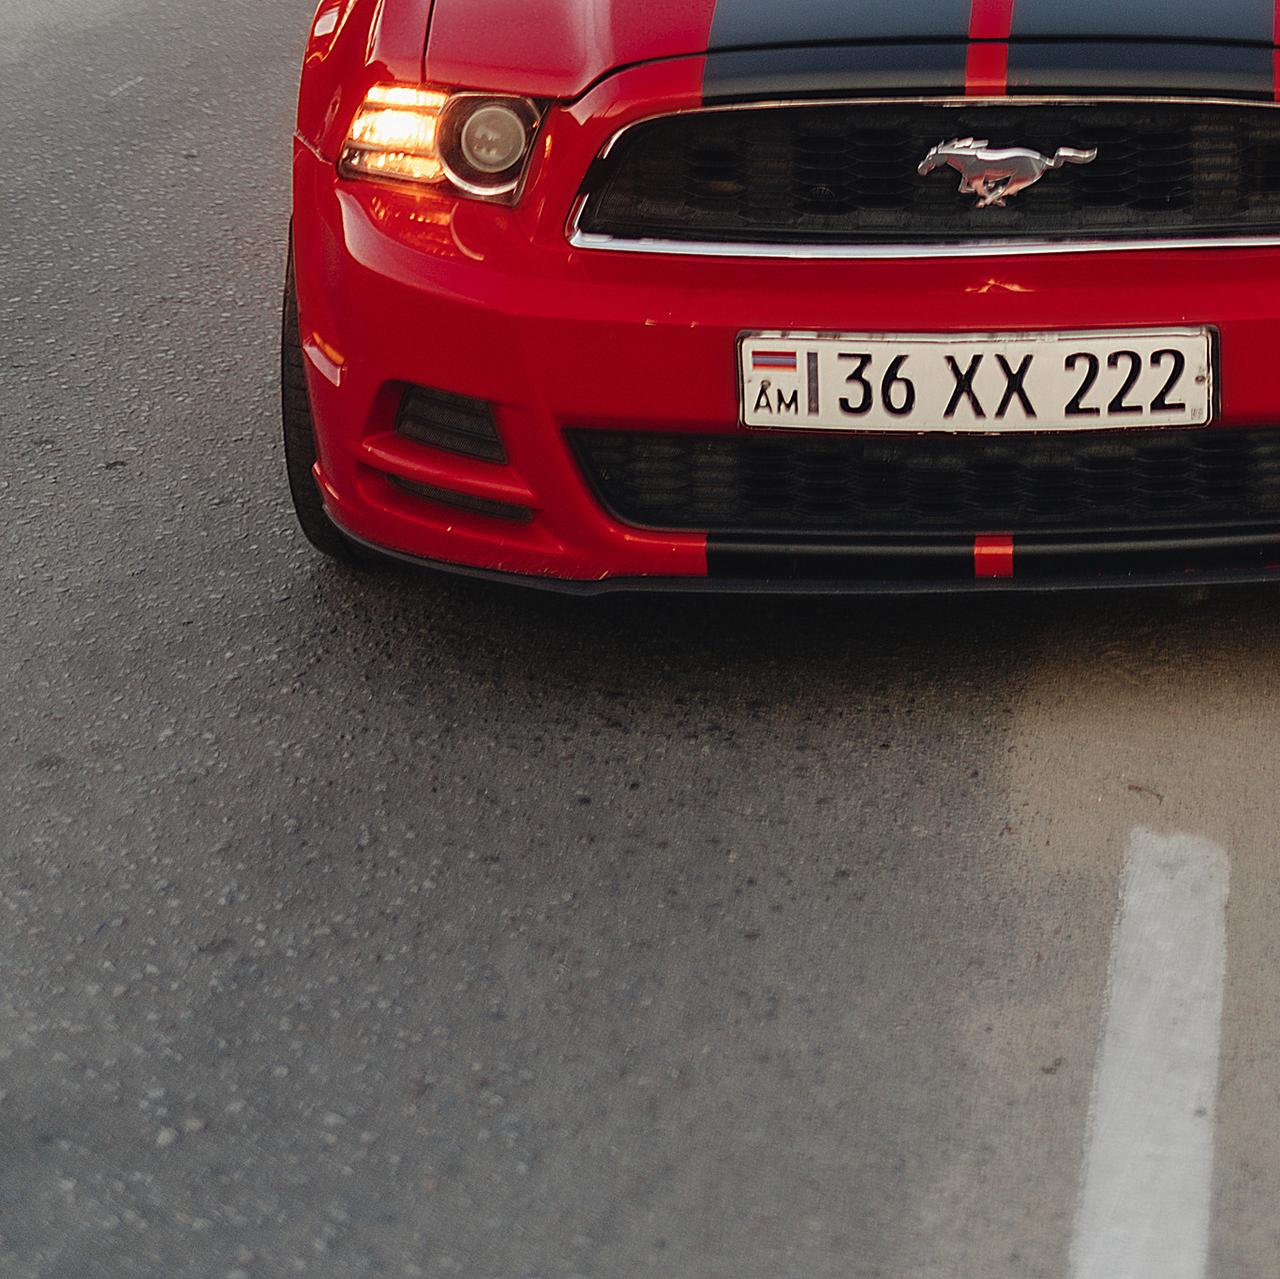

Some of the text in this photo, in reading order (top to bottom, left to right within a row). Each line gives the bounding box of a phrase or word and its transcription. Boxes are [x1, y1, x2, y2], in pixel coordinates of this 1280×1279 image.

[753, 384, 799, 415] AM
[838, 348, 1186, 419] 36 XX 222
